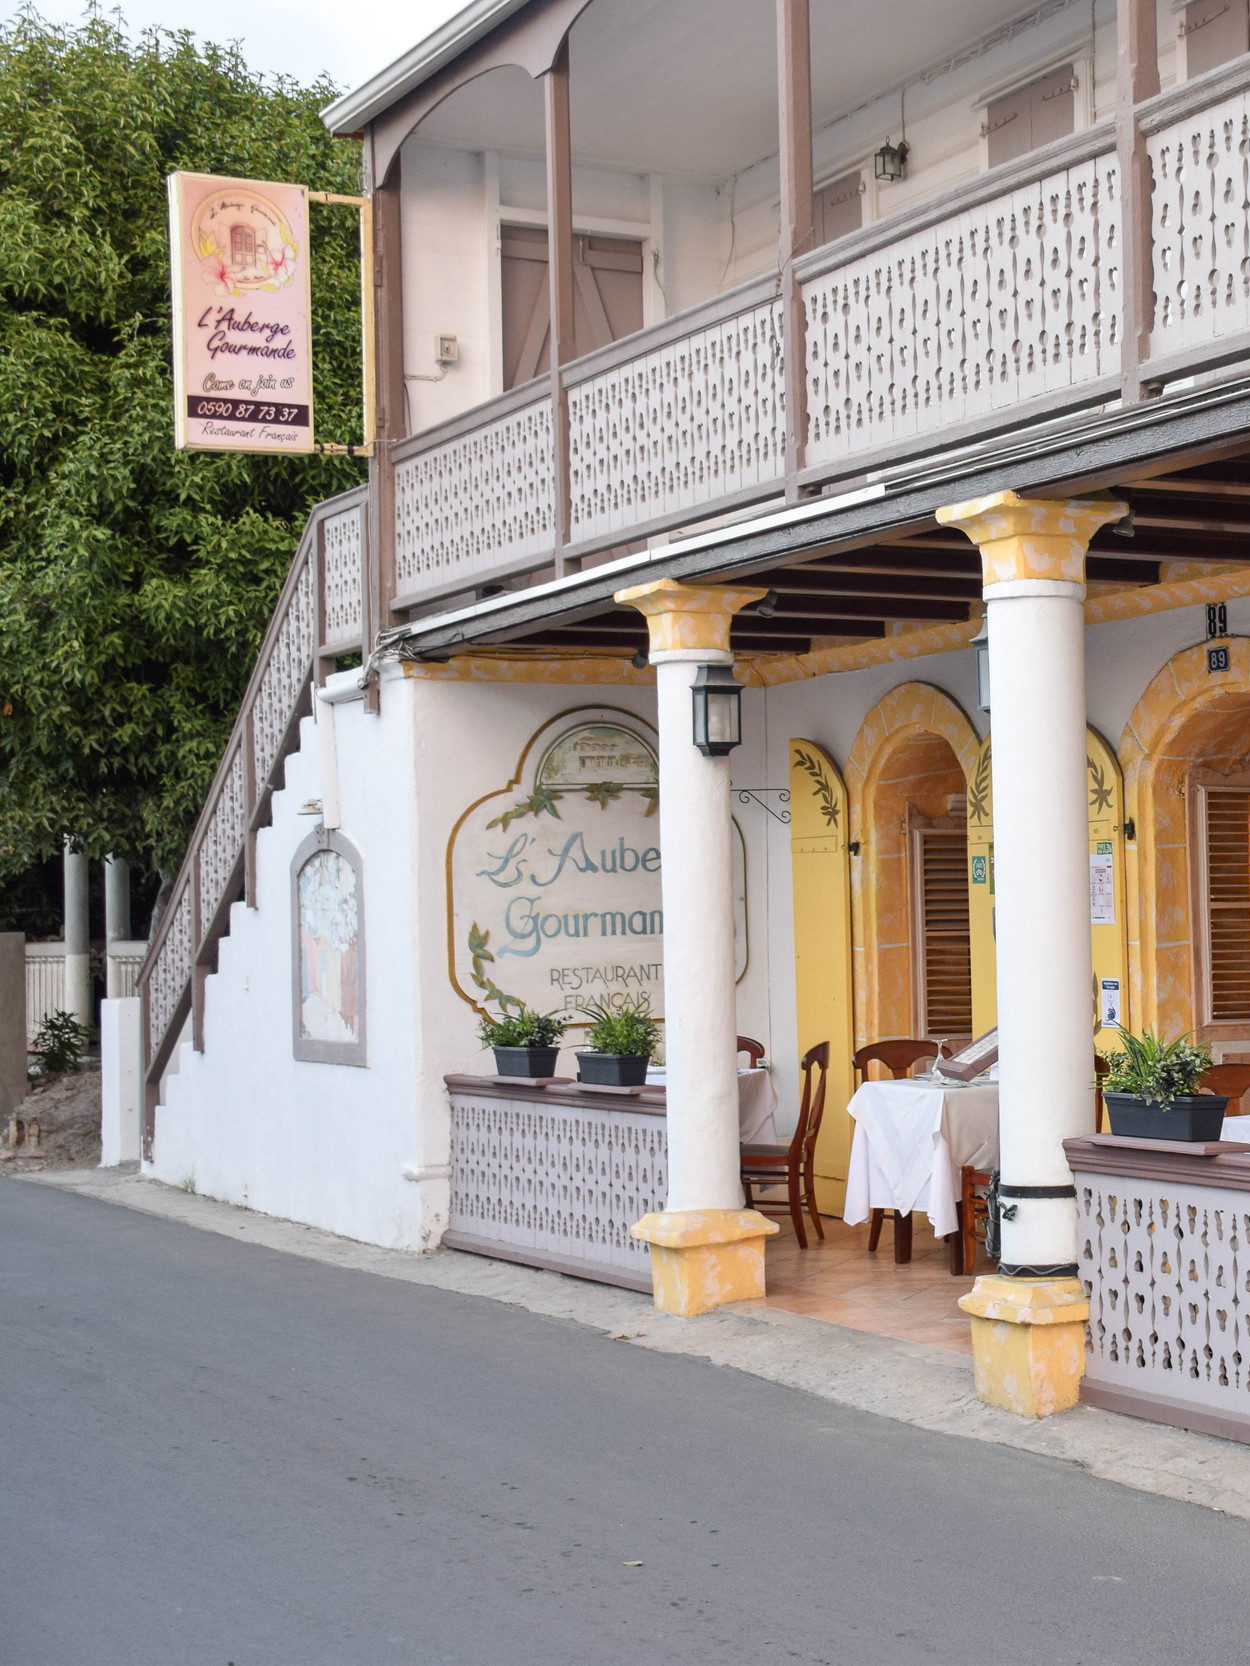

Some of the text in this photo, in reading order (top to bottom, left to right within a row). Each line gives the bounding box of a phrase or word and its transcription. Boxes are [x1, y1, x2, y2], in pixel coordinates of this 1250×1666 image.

[198, 306, 291, 342] L'Auberge
[207, 330, 296, 360] Gourmande
[202, 372, 295, 396] Come on join us
[197, 401, 298, 422] 0590 87 73 37
[202, 421, 298, 442] Restaurant Français
[1208, 605, 1227, 635] 89
[1211, 651, 1226, 668] 89
[550, 963, 662, 990] RESTAURANT
